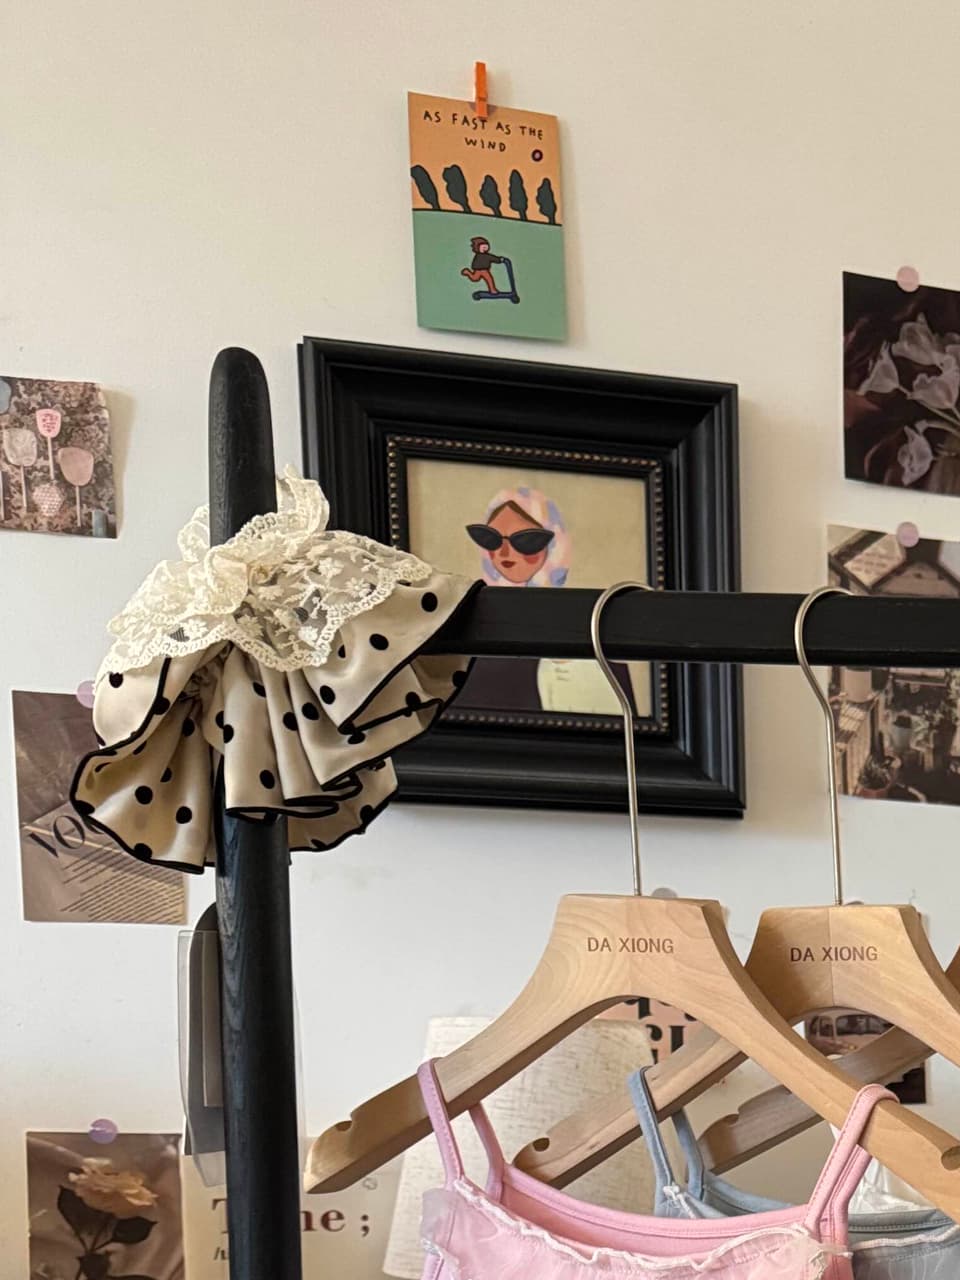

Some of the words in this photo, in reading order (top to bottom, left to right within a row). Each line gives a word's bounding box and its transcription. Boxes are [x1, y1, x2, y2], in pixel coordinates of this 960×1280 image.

[423, 109, 442, 124] AS
[451, 113, 489, 131] FAST
[495, 121, 512, 136] AS
[519, 125, 544, 140] THE
[464, 136, 508, 152] WIND
[586, 936, 613, 953] DA
[618, 936, 675, 954] XIONG
[789, 946, 816, 963] DA
[821, 945, 879, 962] XIONG
